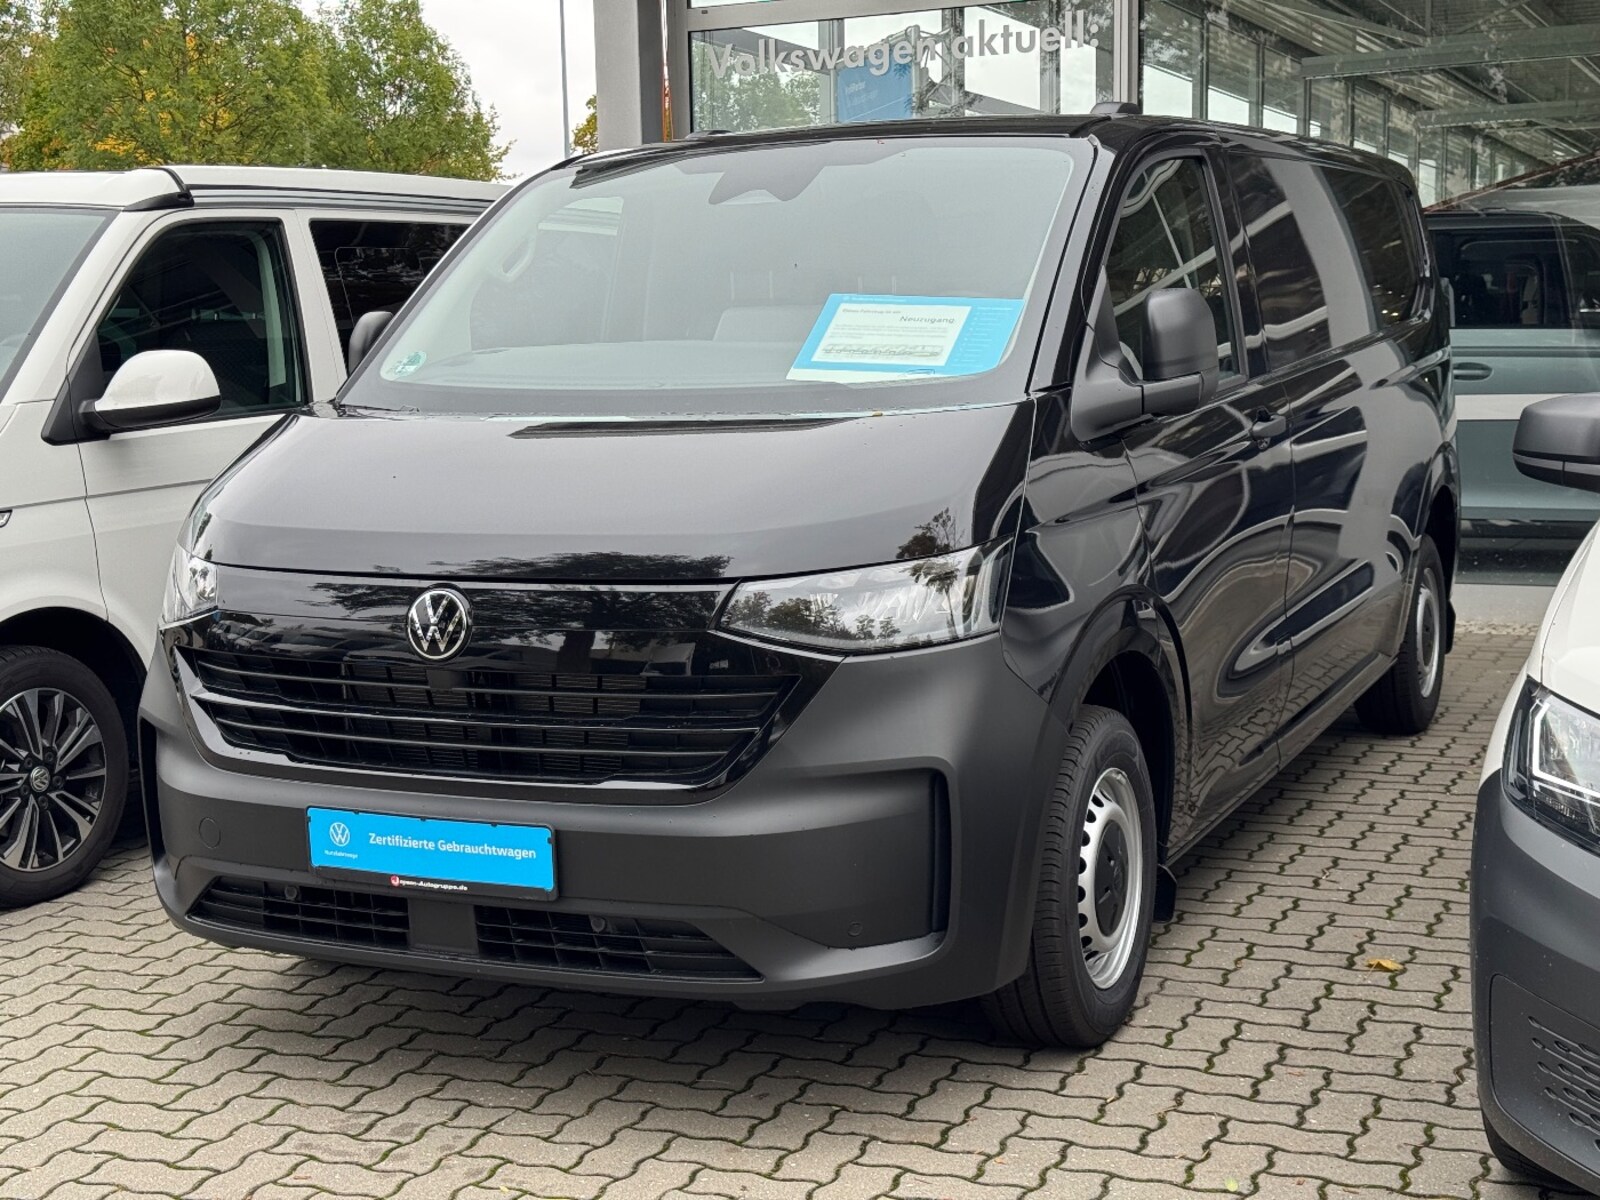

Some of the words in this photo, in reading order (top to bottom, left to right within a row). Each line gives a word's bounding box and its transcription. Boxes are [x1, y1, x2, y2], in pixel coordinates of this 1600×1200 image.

[707, 37, 936, 79] Volkswagen
[952, 10, 1099, 59] aktuell:
[900, 315, 955, 324] Neuzugang
[368, 832, 435, 850] Zertifizierte
[437, 840, 537, 860] Gebrauchtwagen
